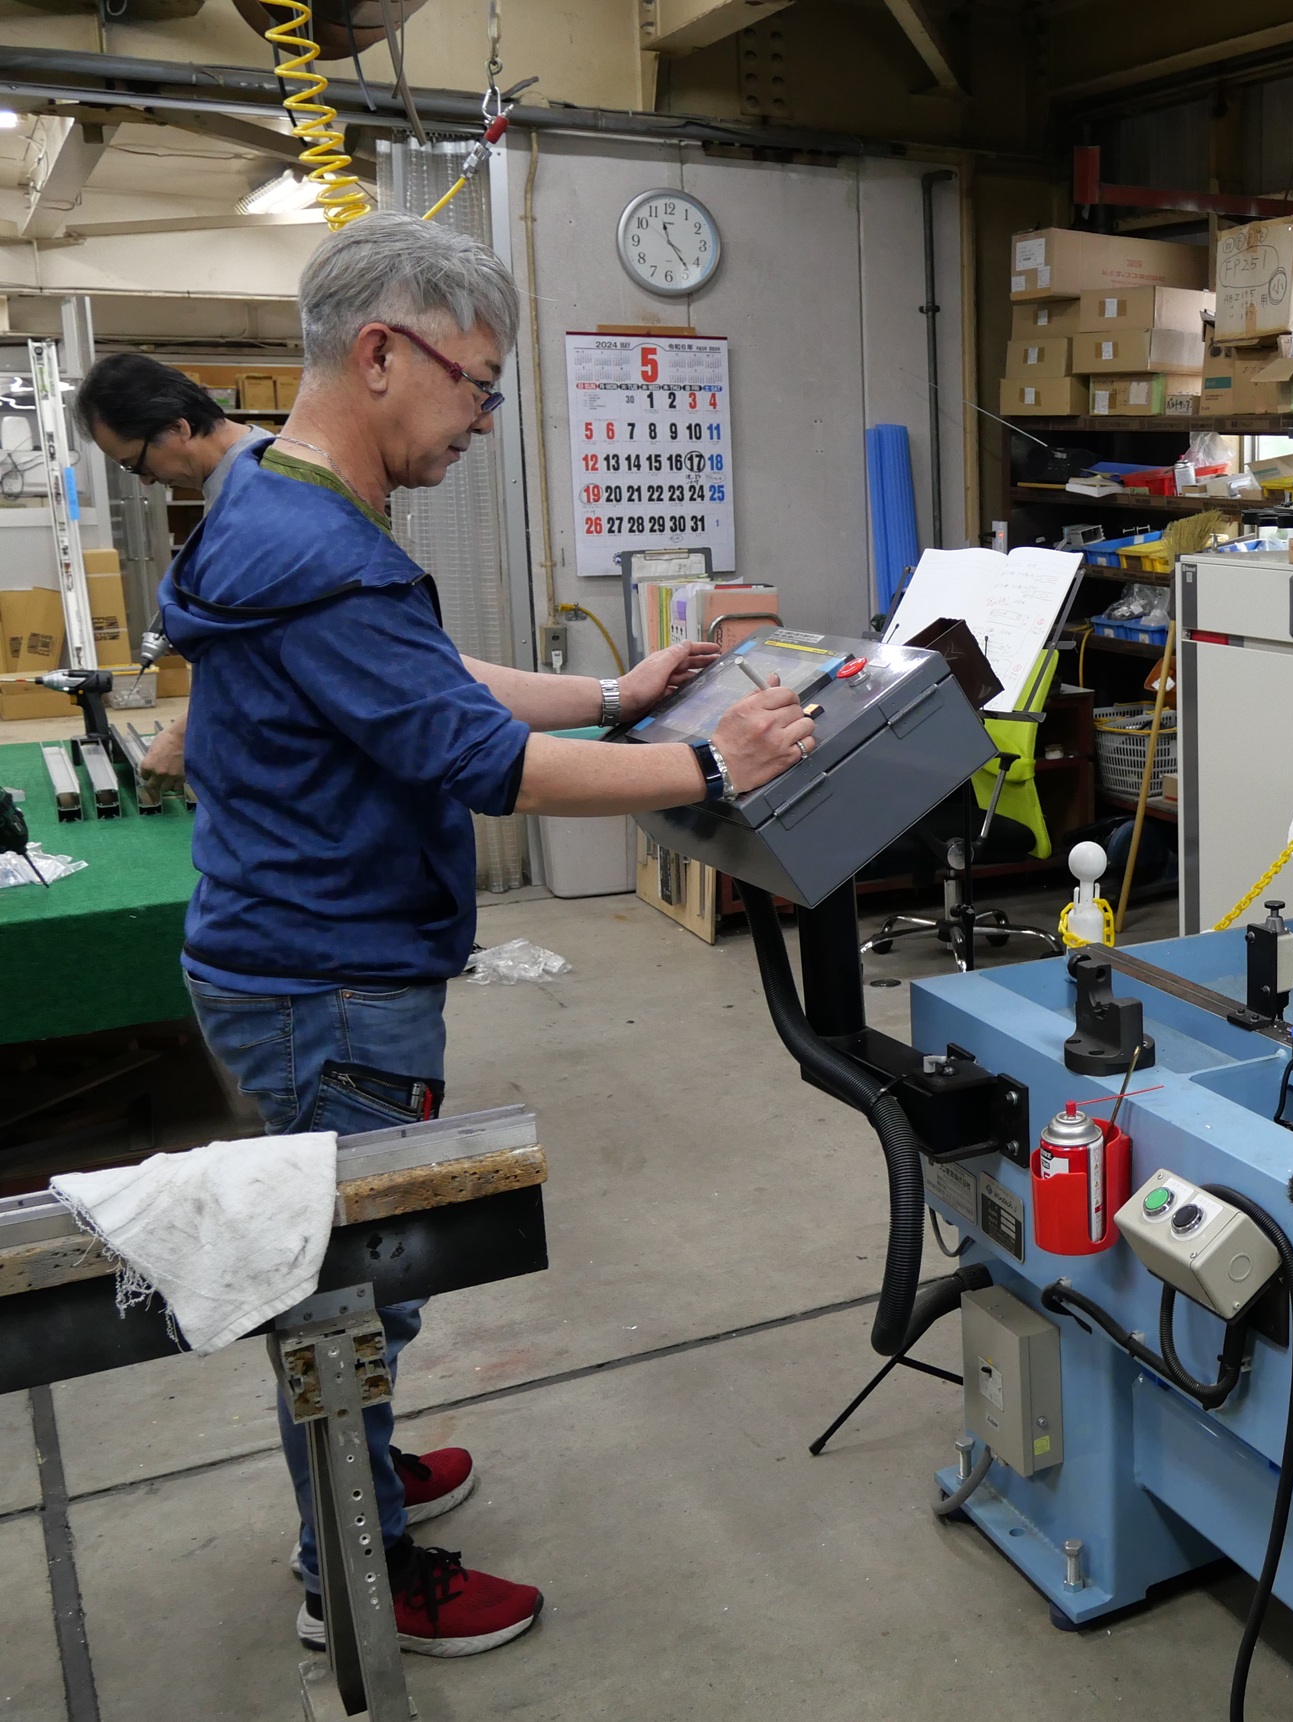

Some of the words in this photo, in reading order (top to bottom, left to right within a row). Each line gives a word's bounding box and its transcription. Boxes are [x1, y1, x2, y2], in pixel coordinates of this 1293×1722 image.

[649, 205, 658, 218] 11
[664, 202, 675, 215] 12
[685, 209, 689, 220] 1
[637, 217, 648, 230] 10
[694, 222, 702, 234] 2
[632, 234, 640, 247] 9
[698, 240, 707, 252] 3
[637, 252, 646, 264] 8
[693, 256, 701, 267] 4
[1225, 249, 1267, 280] FP251
[650, 265, 657, 277] 7
[665, 270, 673, 282] 6
[682, 268, 689, 280] 5
[640, 347, 658, 383] 5
[626, 395, 634, 404] 30
[647, 392, 654, 409] 1
[668, 392, 676, 409] 2
[688, 392, 697, 409] 3
[709, 392, 717, 410] 4
[584, 422, 593, 440] 5
[606, 422, 615, 440] 6
[627, 423, 636, 440] 7
[648, 422, 657, 440] 8
[669, 423, 678, 440] 9
[686, 423, 702, 440] 10
[707, 423, 721, 440] 11
[582, 454, 598, 471] 12
[603, 454, 620, 471] 13
[625, 454, 641, 471] 14
[646, 454, 662, 471] 15
[667, 454, 683, 471] 16
[687, 454, 704, 471] 17
[708, 454, 723, 471] 18
[584, 485, 601, 503] 19
[605, 485, 622, 502] 20
[627, 485, 642, 502] 21
[647, 485, 664, 502] 22
[668, 485, 685, 502] 23
[688, 485, 705, 501] 24
[709, 484, 725, 501] 25
[585, 516, 603, 534] 26
[607, 517, 623, 534] 27
[628, 516, 644, 533] 28
[649, 516, 665, 533] 29
[670, 515, 686, 533] 30
[690, 515, 705, 532] 31
[715, 519, 719, 527] 1
